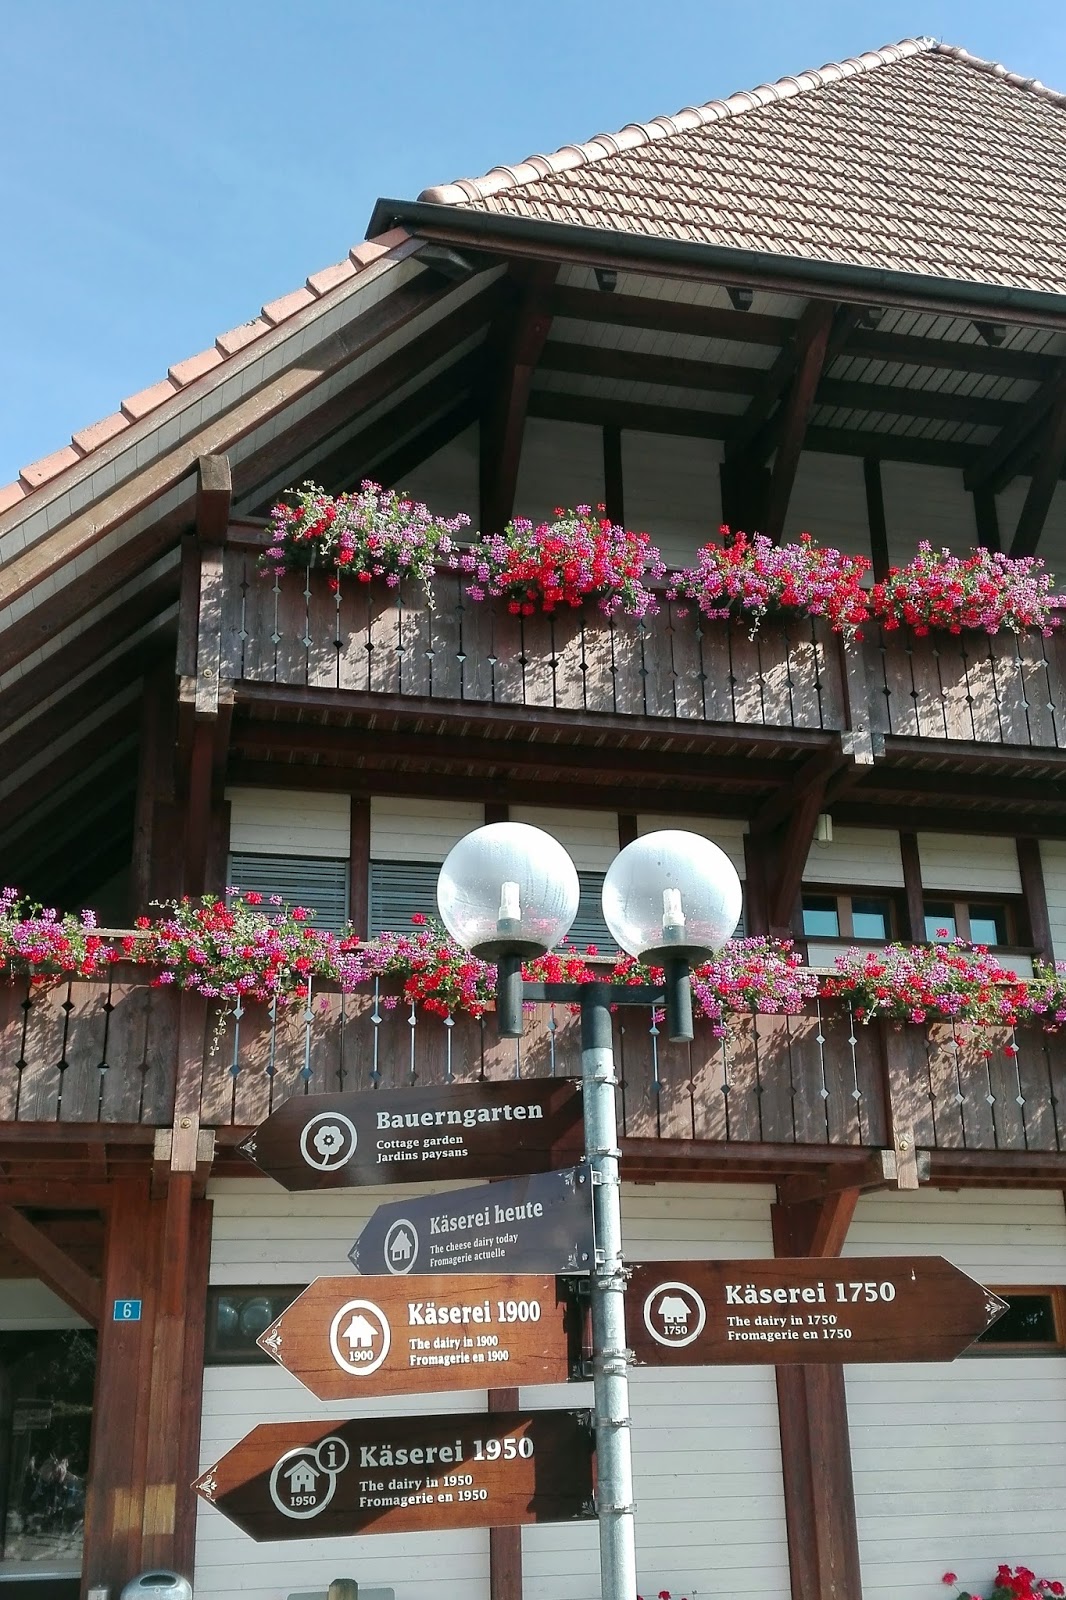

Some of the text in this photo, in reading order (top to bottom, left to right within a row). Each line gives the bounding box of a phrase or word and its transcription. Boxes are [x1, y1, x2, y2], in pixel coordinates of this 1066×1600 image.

[376, 1104, 543, 1129] Bauerngarten
[377, 1135, 463, 1150] Cottage garden
[376, 1148, 468, 1163] Jardins paysans
[430, 1200, 543, 1235] Käserei heute
[430, 1233, 518, 1254] The cheese dairy today
[430, 1248, 505, 1267] Fromagerie actuelle
[725, 1282, 895, 1305] Käserei 1750
[123, 1303, 132, 1318] 6
[408, 1300, 540, 1326] Käserei 1900
[727, 1315, 837, 1328] The dairy in 1750
[663, 1326, 687, 1335] 1750
[727, 1329, 852, 1342] Fromagerie en 1750
[409, 1335, 498, 1351] The dairy in 1900
[349, 1350, 373, 1362] 1900
[409, 1351, 509, 1367] Fromagerie en 1900
[359, 1438, 534, 1468] Käserei 1950
[359, 1475, 473, 1492] The dairy in 1950
[290, 1495, 316, 1506] 1950
[359, 1490, 487, 1509] Fromagerie en 1950
